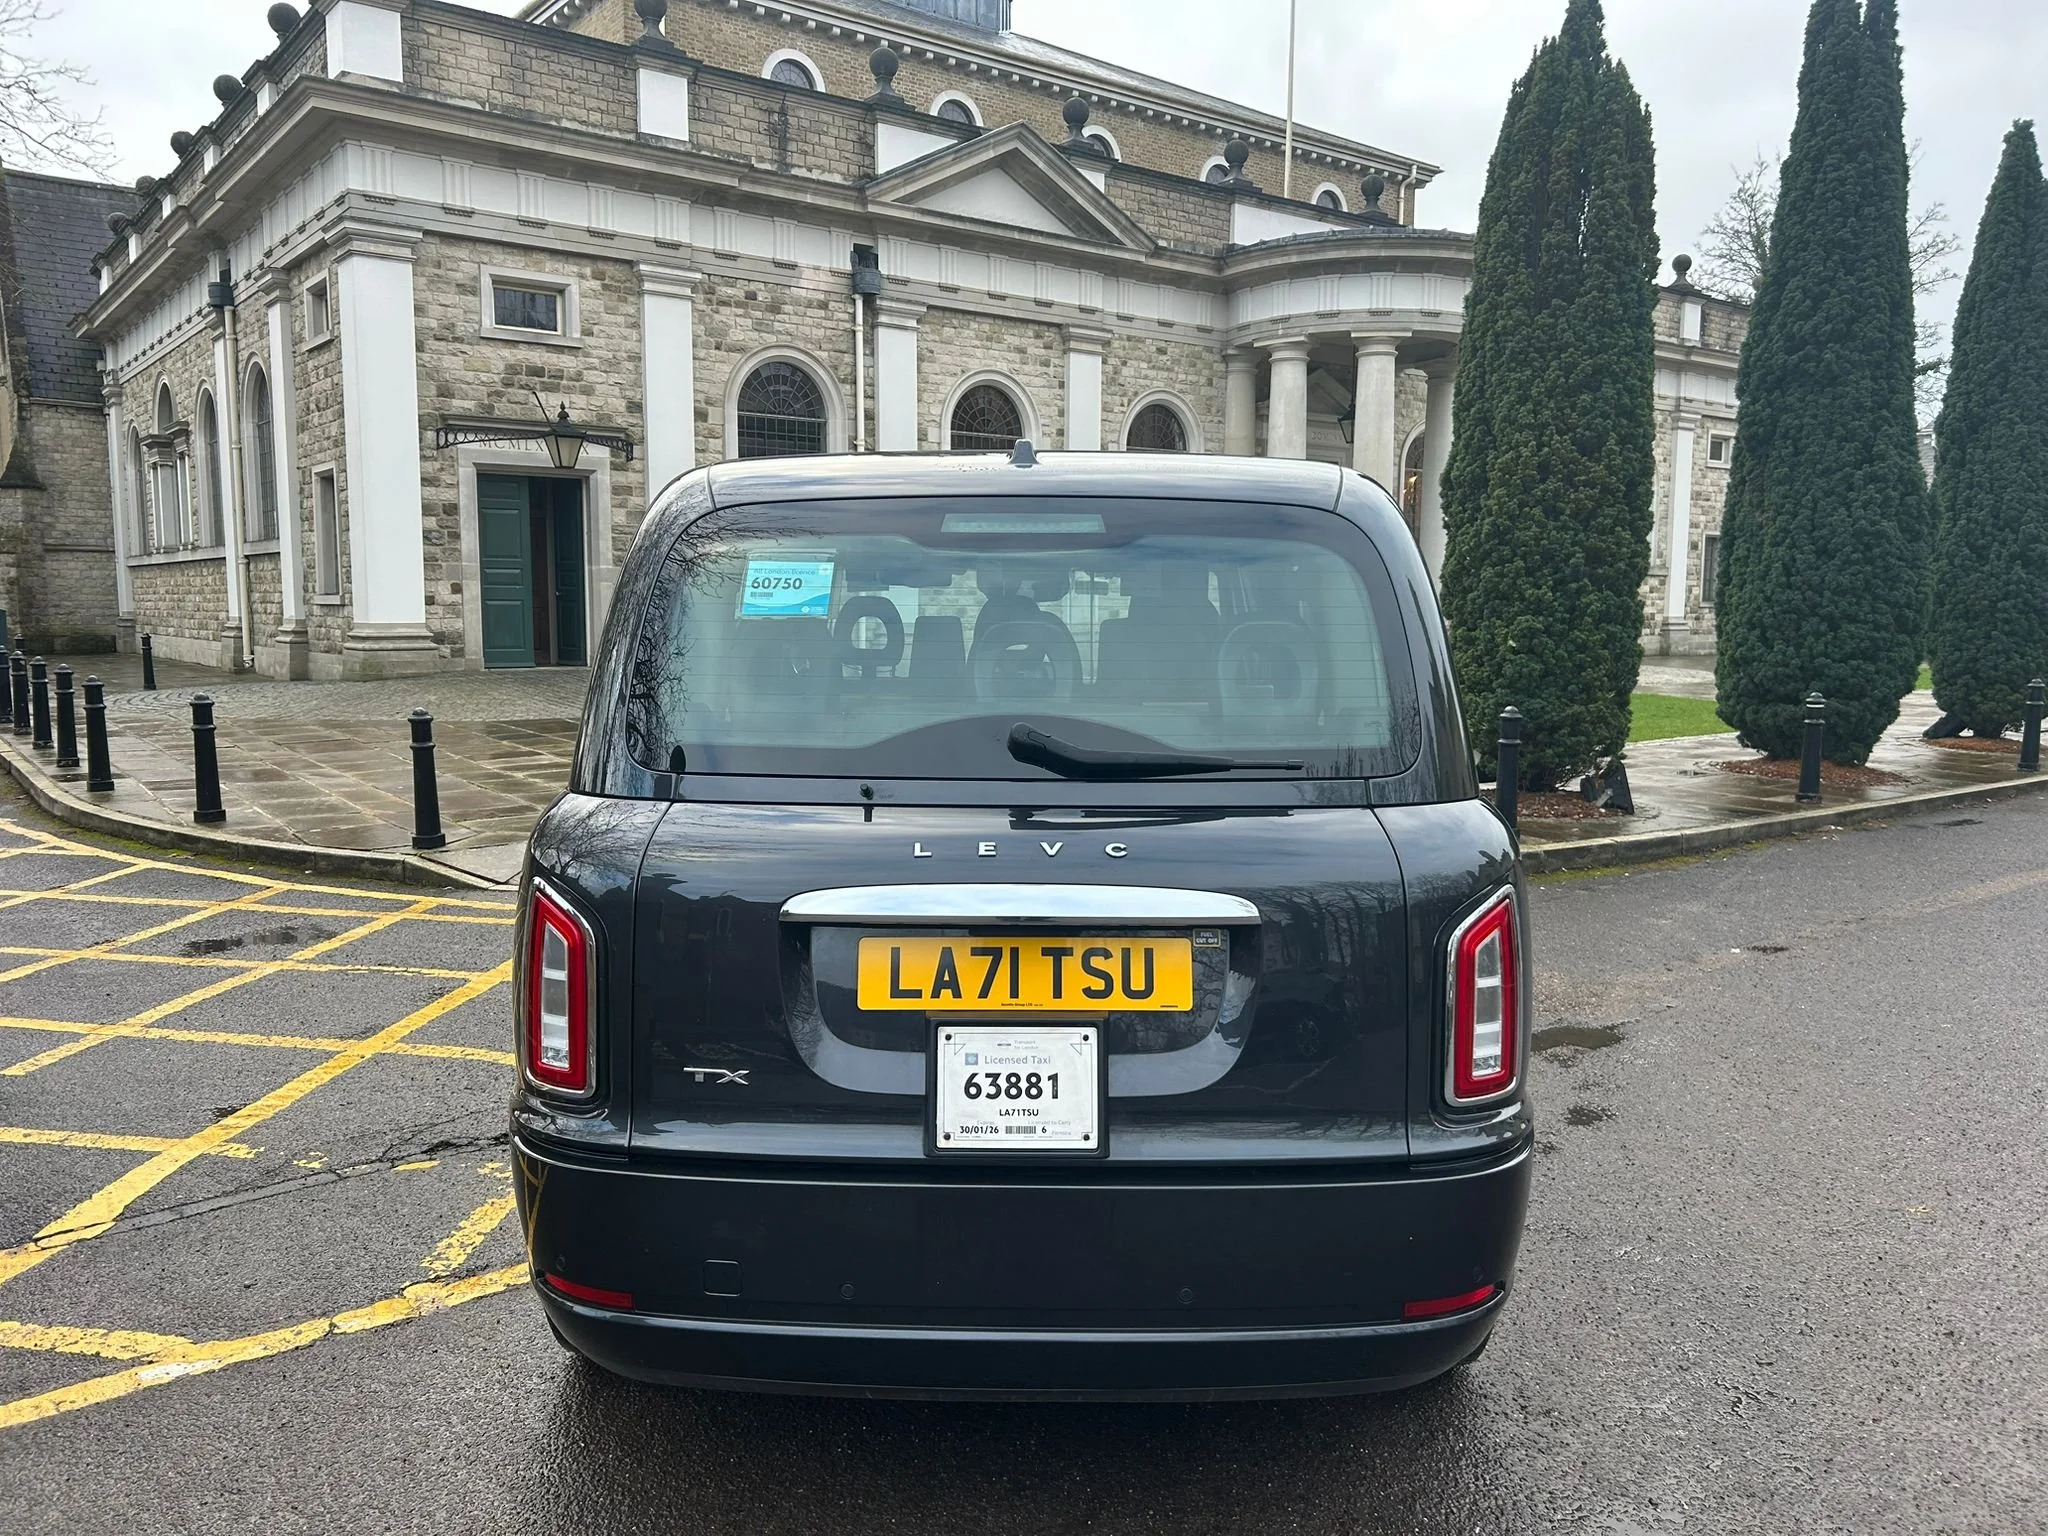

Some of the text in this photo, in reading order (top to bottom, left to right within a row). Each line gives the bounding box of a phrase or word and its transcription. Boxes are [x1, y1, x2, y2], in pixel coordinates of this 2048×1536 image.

[751, 577, 803, 590] 60750
[913, 841, 1129, 858] LEVC
[889, 945, 1155, 1001] LA71 TSU
[984, 1055, 1052, 1065] Licensed Taxi
[683, 1067, 751, 1086] TX
[963, 1072, 1059, 1100] 63881
[999, 1108, 1039, 1117] LA71TSU
[959, 1125, 1000, 1135] 30/01/26
[1041, 1125, 1048, 1135] 6
